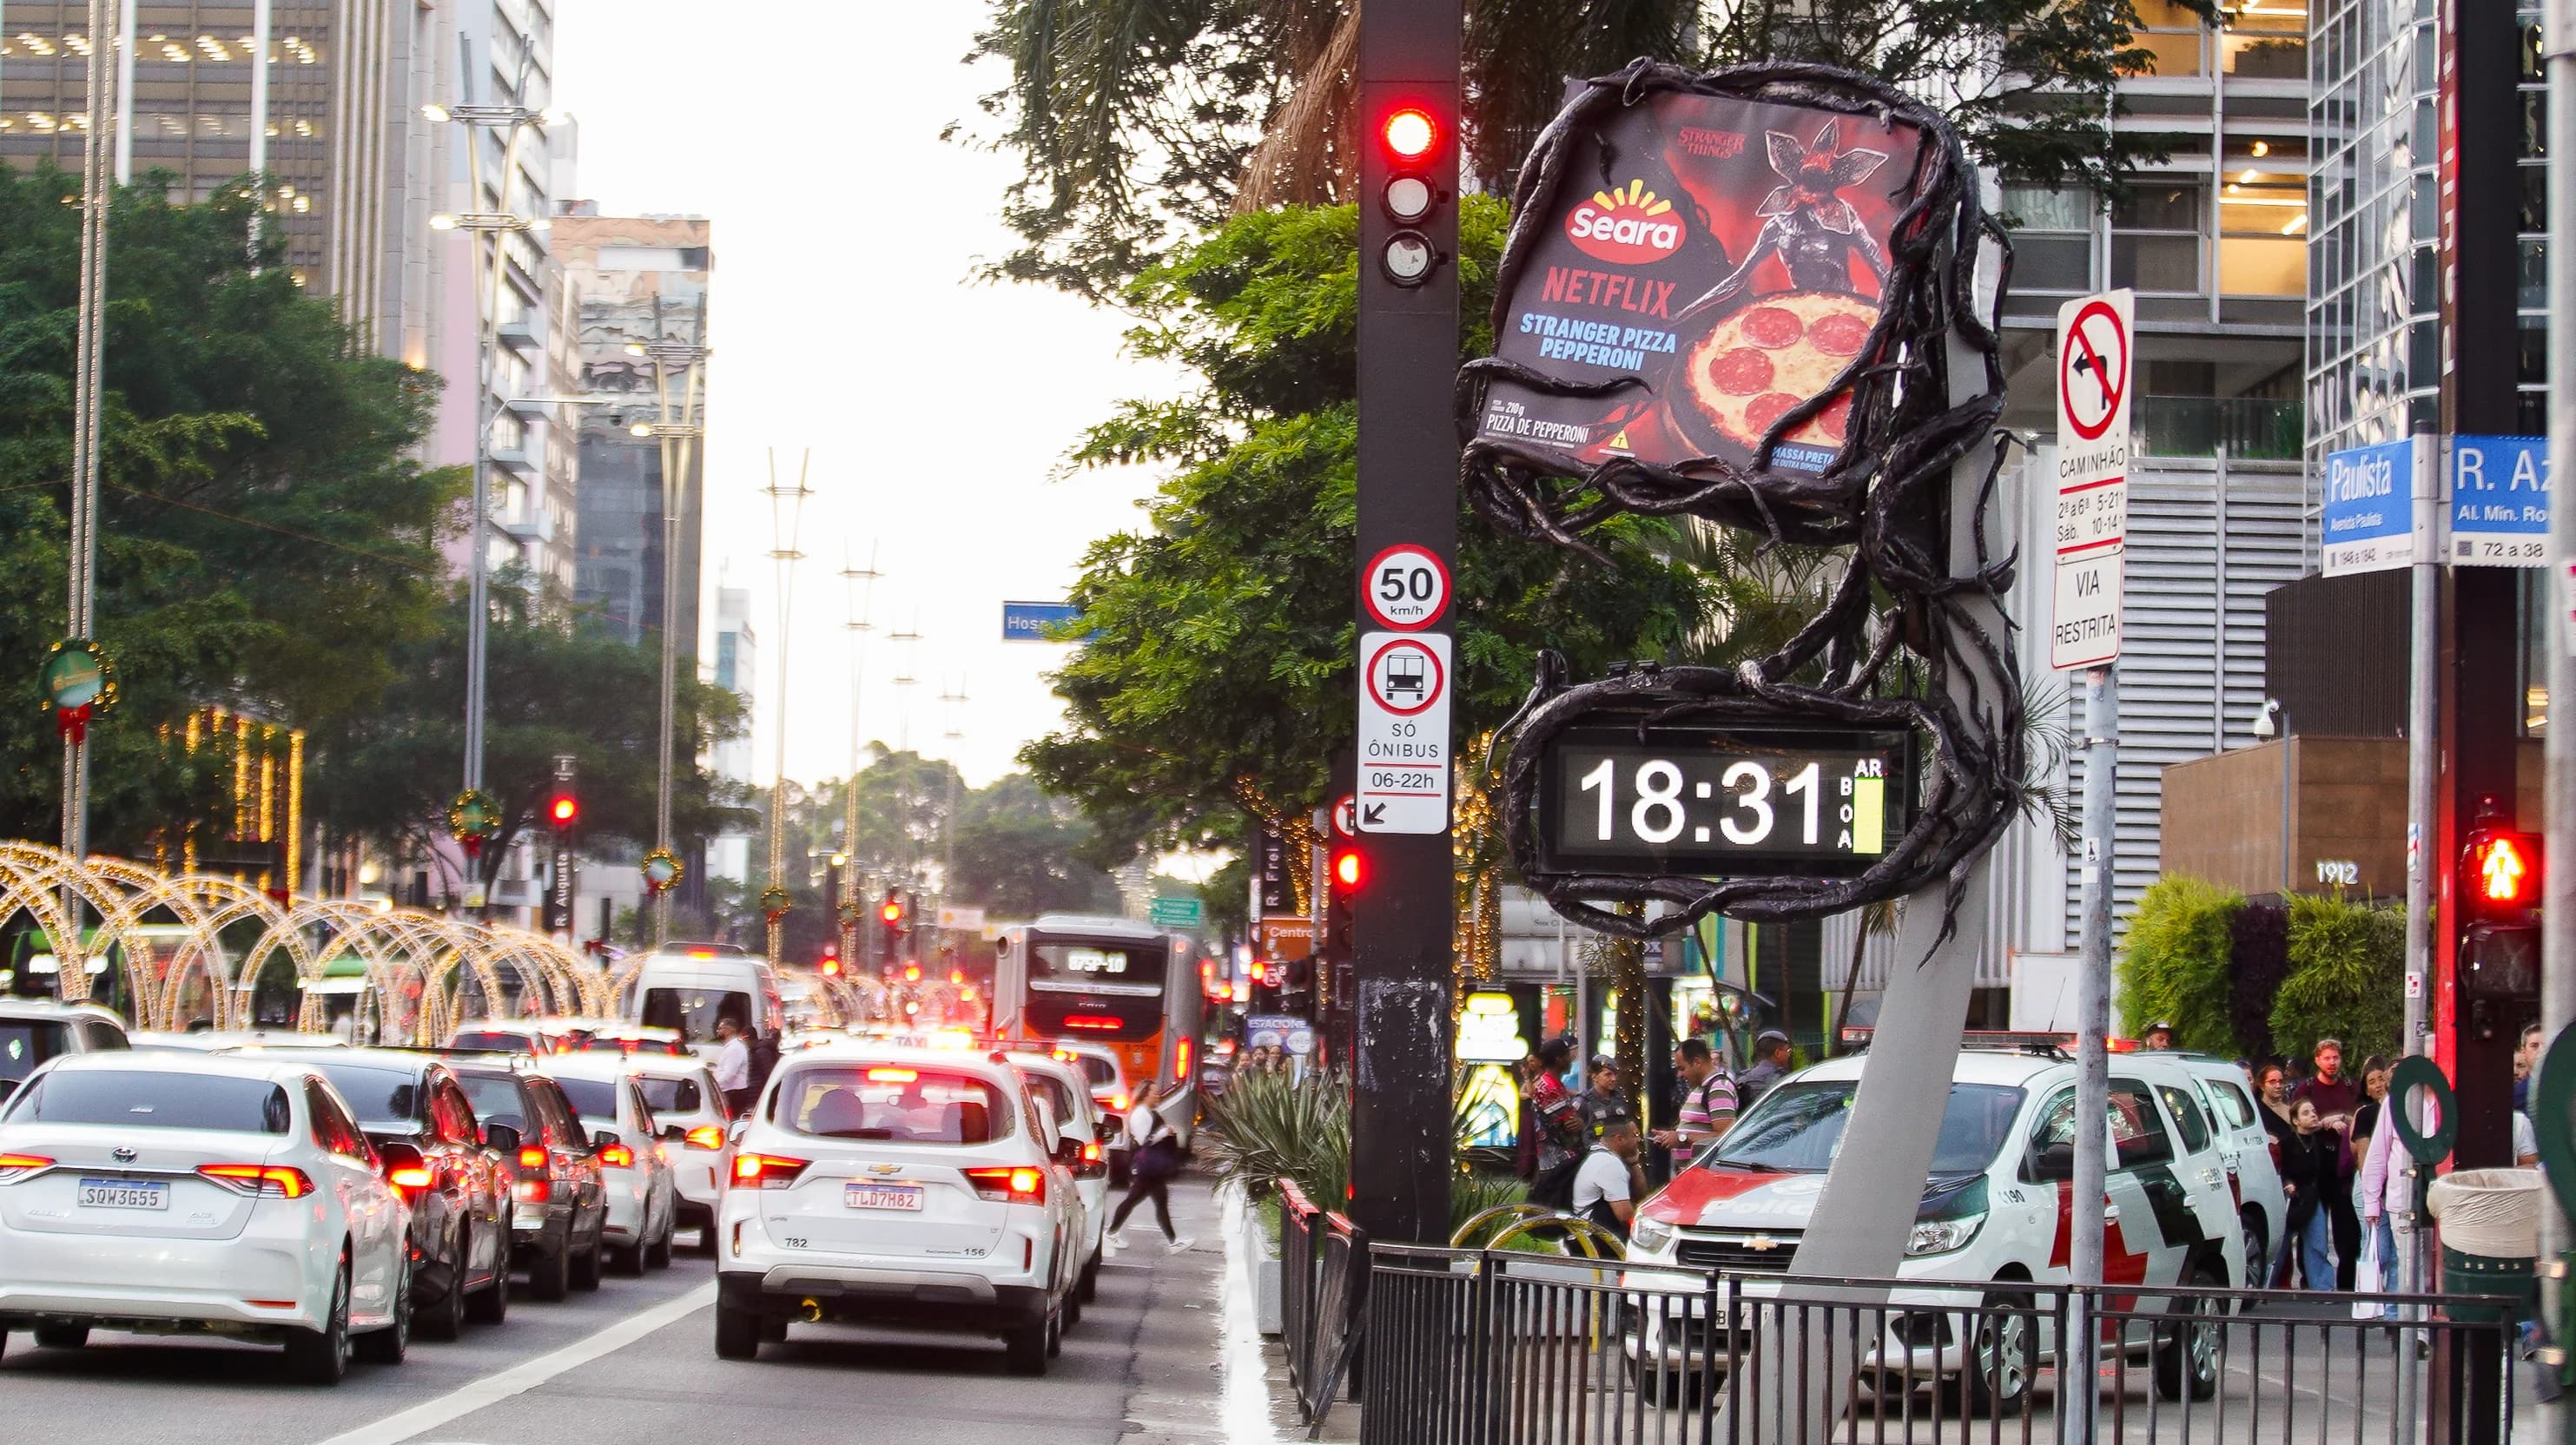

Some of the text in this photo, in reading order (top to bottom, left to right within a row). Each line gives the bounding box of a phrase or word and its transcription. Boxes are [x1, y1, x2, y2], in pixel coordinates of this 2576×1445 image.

[1570, 208, 1679, 250] Seara
[1542, 266, 1677, 320] NETFLIX
[1520, 313, 1677, 353] STRANGER PIZZA
[1539, 337, 1644, 372] PEPPERONI
[1505, 401, 1525, 417] 210g
[1486, 414, 1515, 432] PIZZA
[1516, 418, 1530, 436] DE
[1532, 420, 1589, 444] PEPPERONI
[2060, 444, 2125, 478] CAMINHÃO
[2457, 447, 2495, 491] R.
[2330, 453, 2393, 502] Paulista
[2484, 505, 2519, 522] Min.
[2057, 523, 2079, 542] Sáb.
[2483, 542, 2544, 558] 72 a 38
[1381, 567, 1434, 602] 50
[2076, 569, 2100, 598] VIA
[1390, 604, 1423, 616] km/h
[2055, 613, 2116, 646] RESTRITA
[1391, 720, 1417, 738] SÓ
[1368, 740, 1439, 758] ÔNIBUS
[1853, 758, 1883, 779] AR
[1371, 772, 1435, 789] 06-22h
[1581, 759, 1820, 845] 18:31
[1265, 848, 1279, 881] Frei
[2316, 861, 2359, 885] 1912
[554, 853, 570, 927] R. Augusta
[1265, 890, 1279, 907] R.
[1247, 1018, 1307, 1029] ESTACIONE
[895, 1036, 928, 1048] TAXI
[86, 1188, 159, 1207] SQW3G55
[849, 1191, 915, 1208] TLD7H82
[2004, 1190, 2025, 1204] 190
[784, 1237, 808, 1248] 782
[964, 1248, 986, 1257] 156
